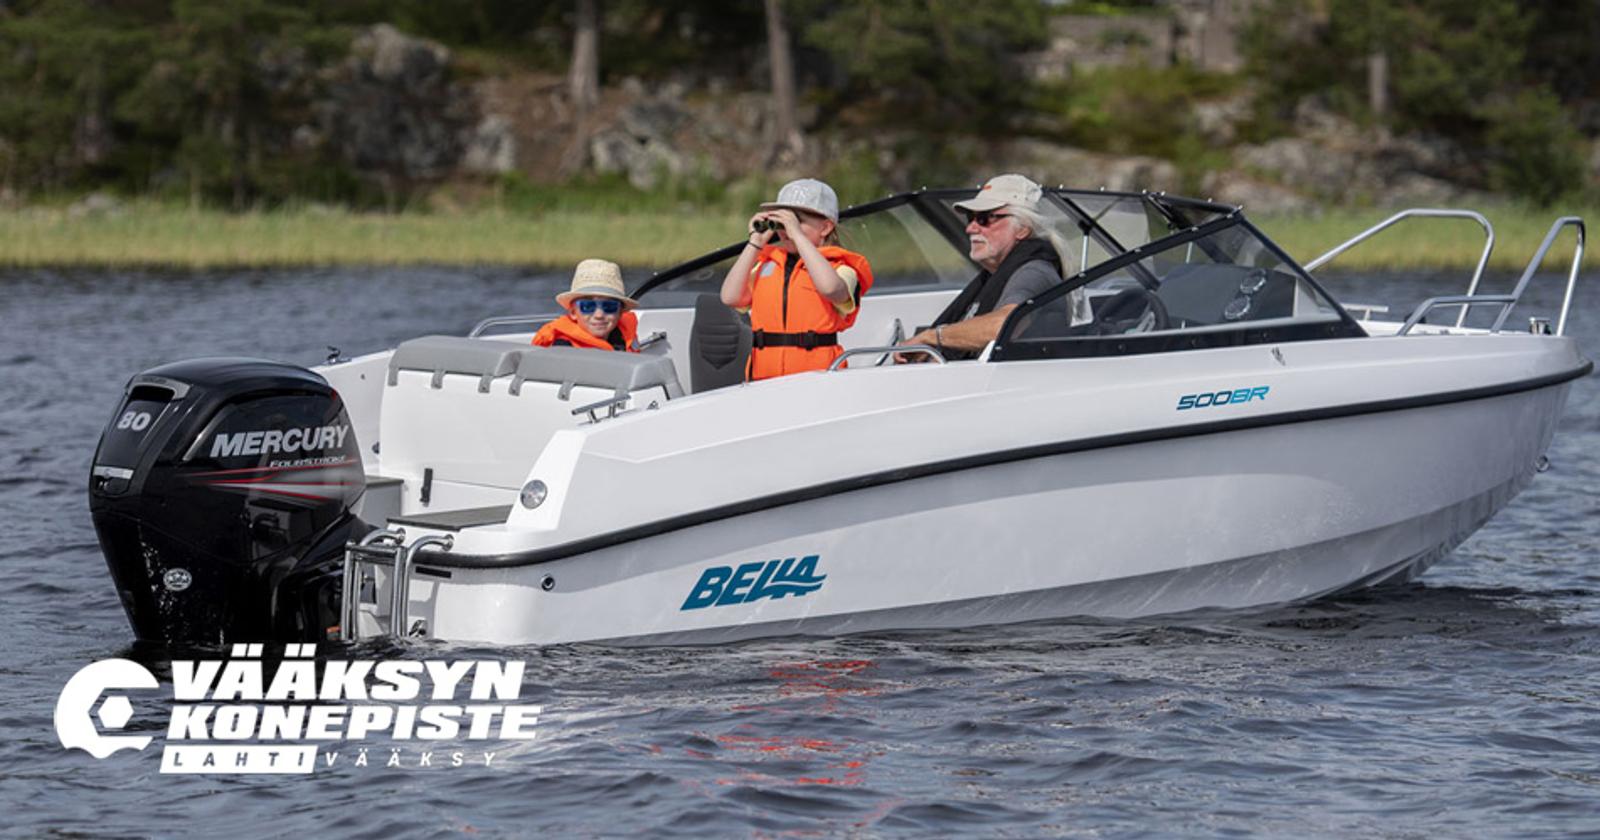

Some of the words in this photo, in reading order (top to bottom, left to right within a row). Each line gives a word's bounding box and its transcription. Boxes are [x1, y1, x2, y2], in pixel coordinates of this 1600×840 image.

[1176, 386, 1270, 410] 500BR
[117, 411, 151, 431] 80
[210, 425, 348, 458] MERCURY
[680, 554, 827, 611] BELLA
